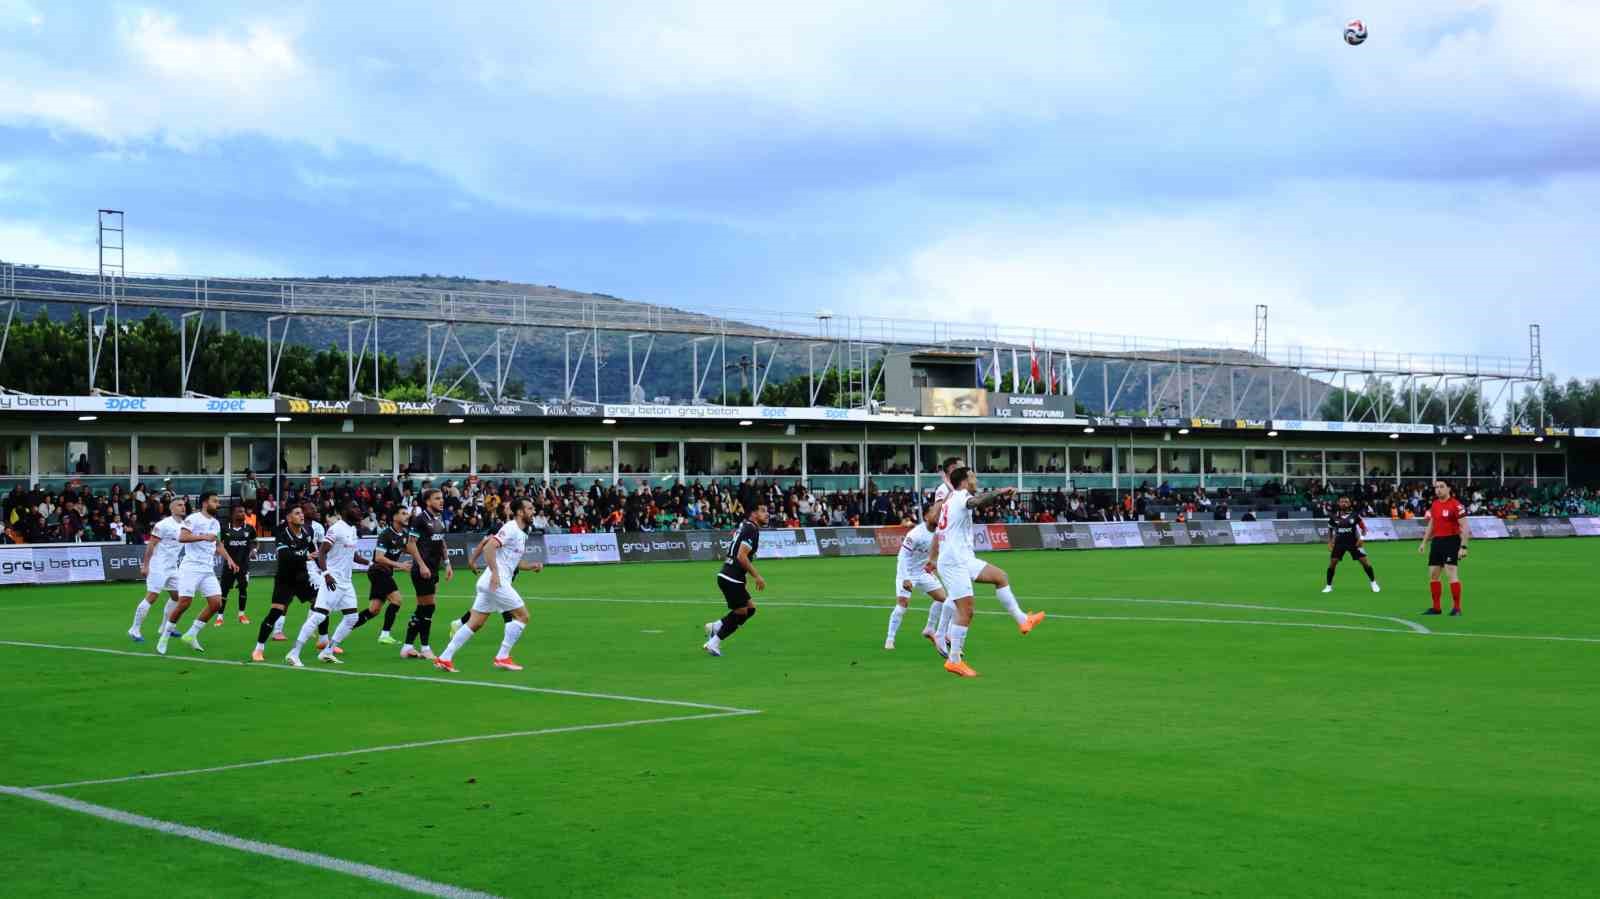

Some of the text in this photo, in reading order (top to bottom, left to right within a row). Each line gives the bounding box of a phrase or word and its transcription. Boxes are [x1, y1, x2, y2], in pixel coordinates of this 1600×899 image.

[17, 395, 68, 407] beton
[104, 398, 147, 411] opet
[206, 399, 246, 411] opet
[309, 400, 350, 409] TALAY
[397, 401, 436, 410] TALAY
[622, 540, 687, 553] grey beton
[2, 558, 99, 574] grey beton
